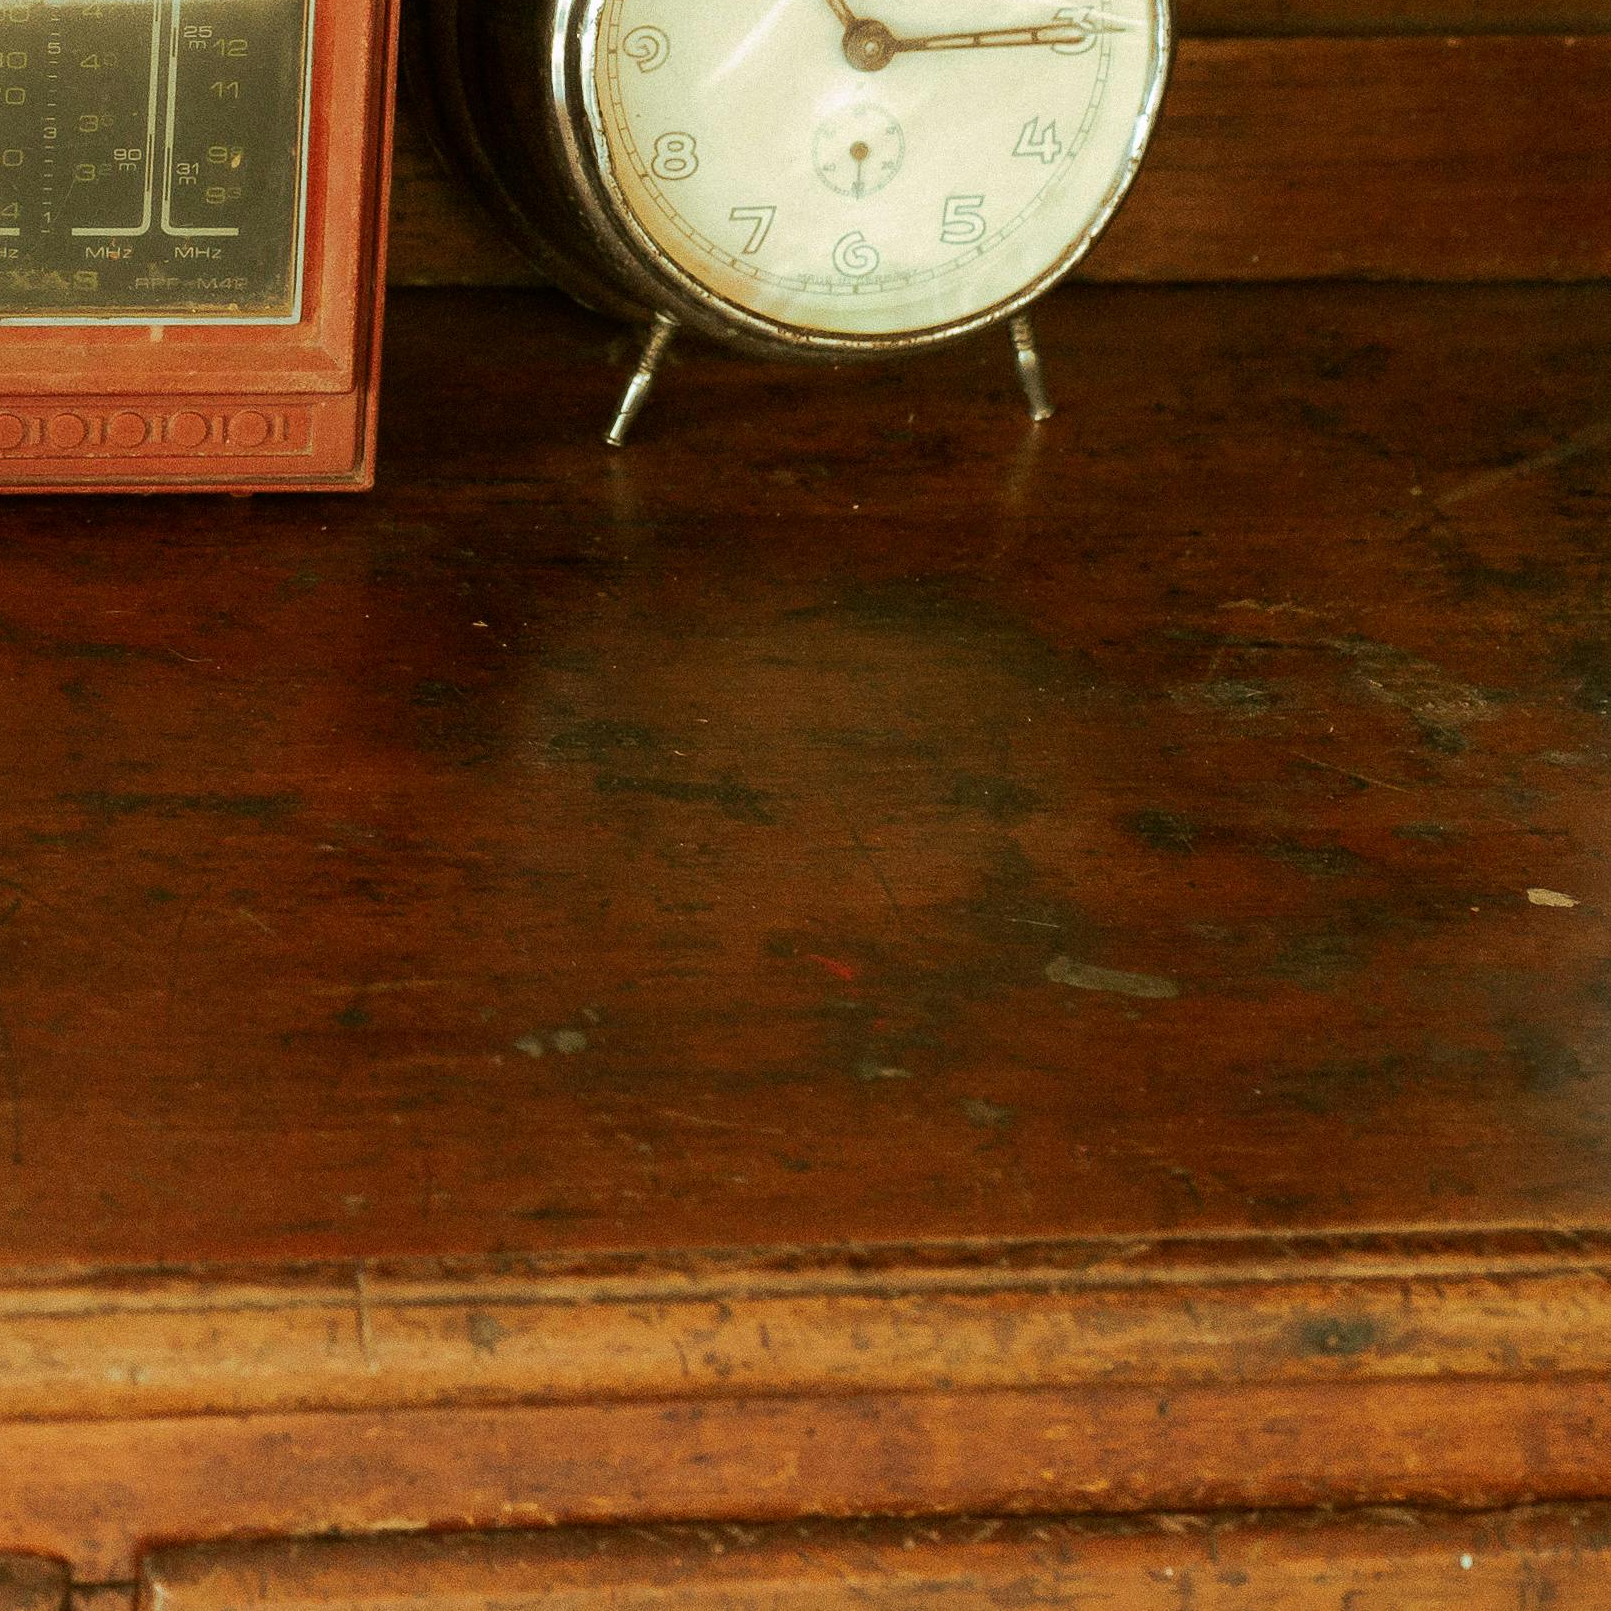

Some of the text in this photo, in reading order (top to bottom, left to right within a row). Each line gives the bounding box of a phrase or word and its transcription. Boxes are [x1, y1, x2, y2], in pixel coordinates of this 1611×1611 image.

[183, 24, 214, 39] 25
[1051, 6, 1098, 56] 3
[46, 41, 63, 56] 5
[212, 38, 249, 58] 12
[622, 25, 671, 74] 9
[209, 80, 241, 100] 11
[42, 126, 58, 141] 3
[1011, 117, 1063, 165] 4
[113, 147, 143, 162] 90
[651, 132, 699, 180] 8
[729, 205, 777, 255] 7
[940, 196, 988, 245] 5
[85, 246, 133, 260] MHz
[174, 246, 222, 260] MHz
[832, 230, 880, 279] 6
